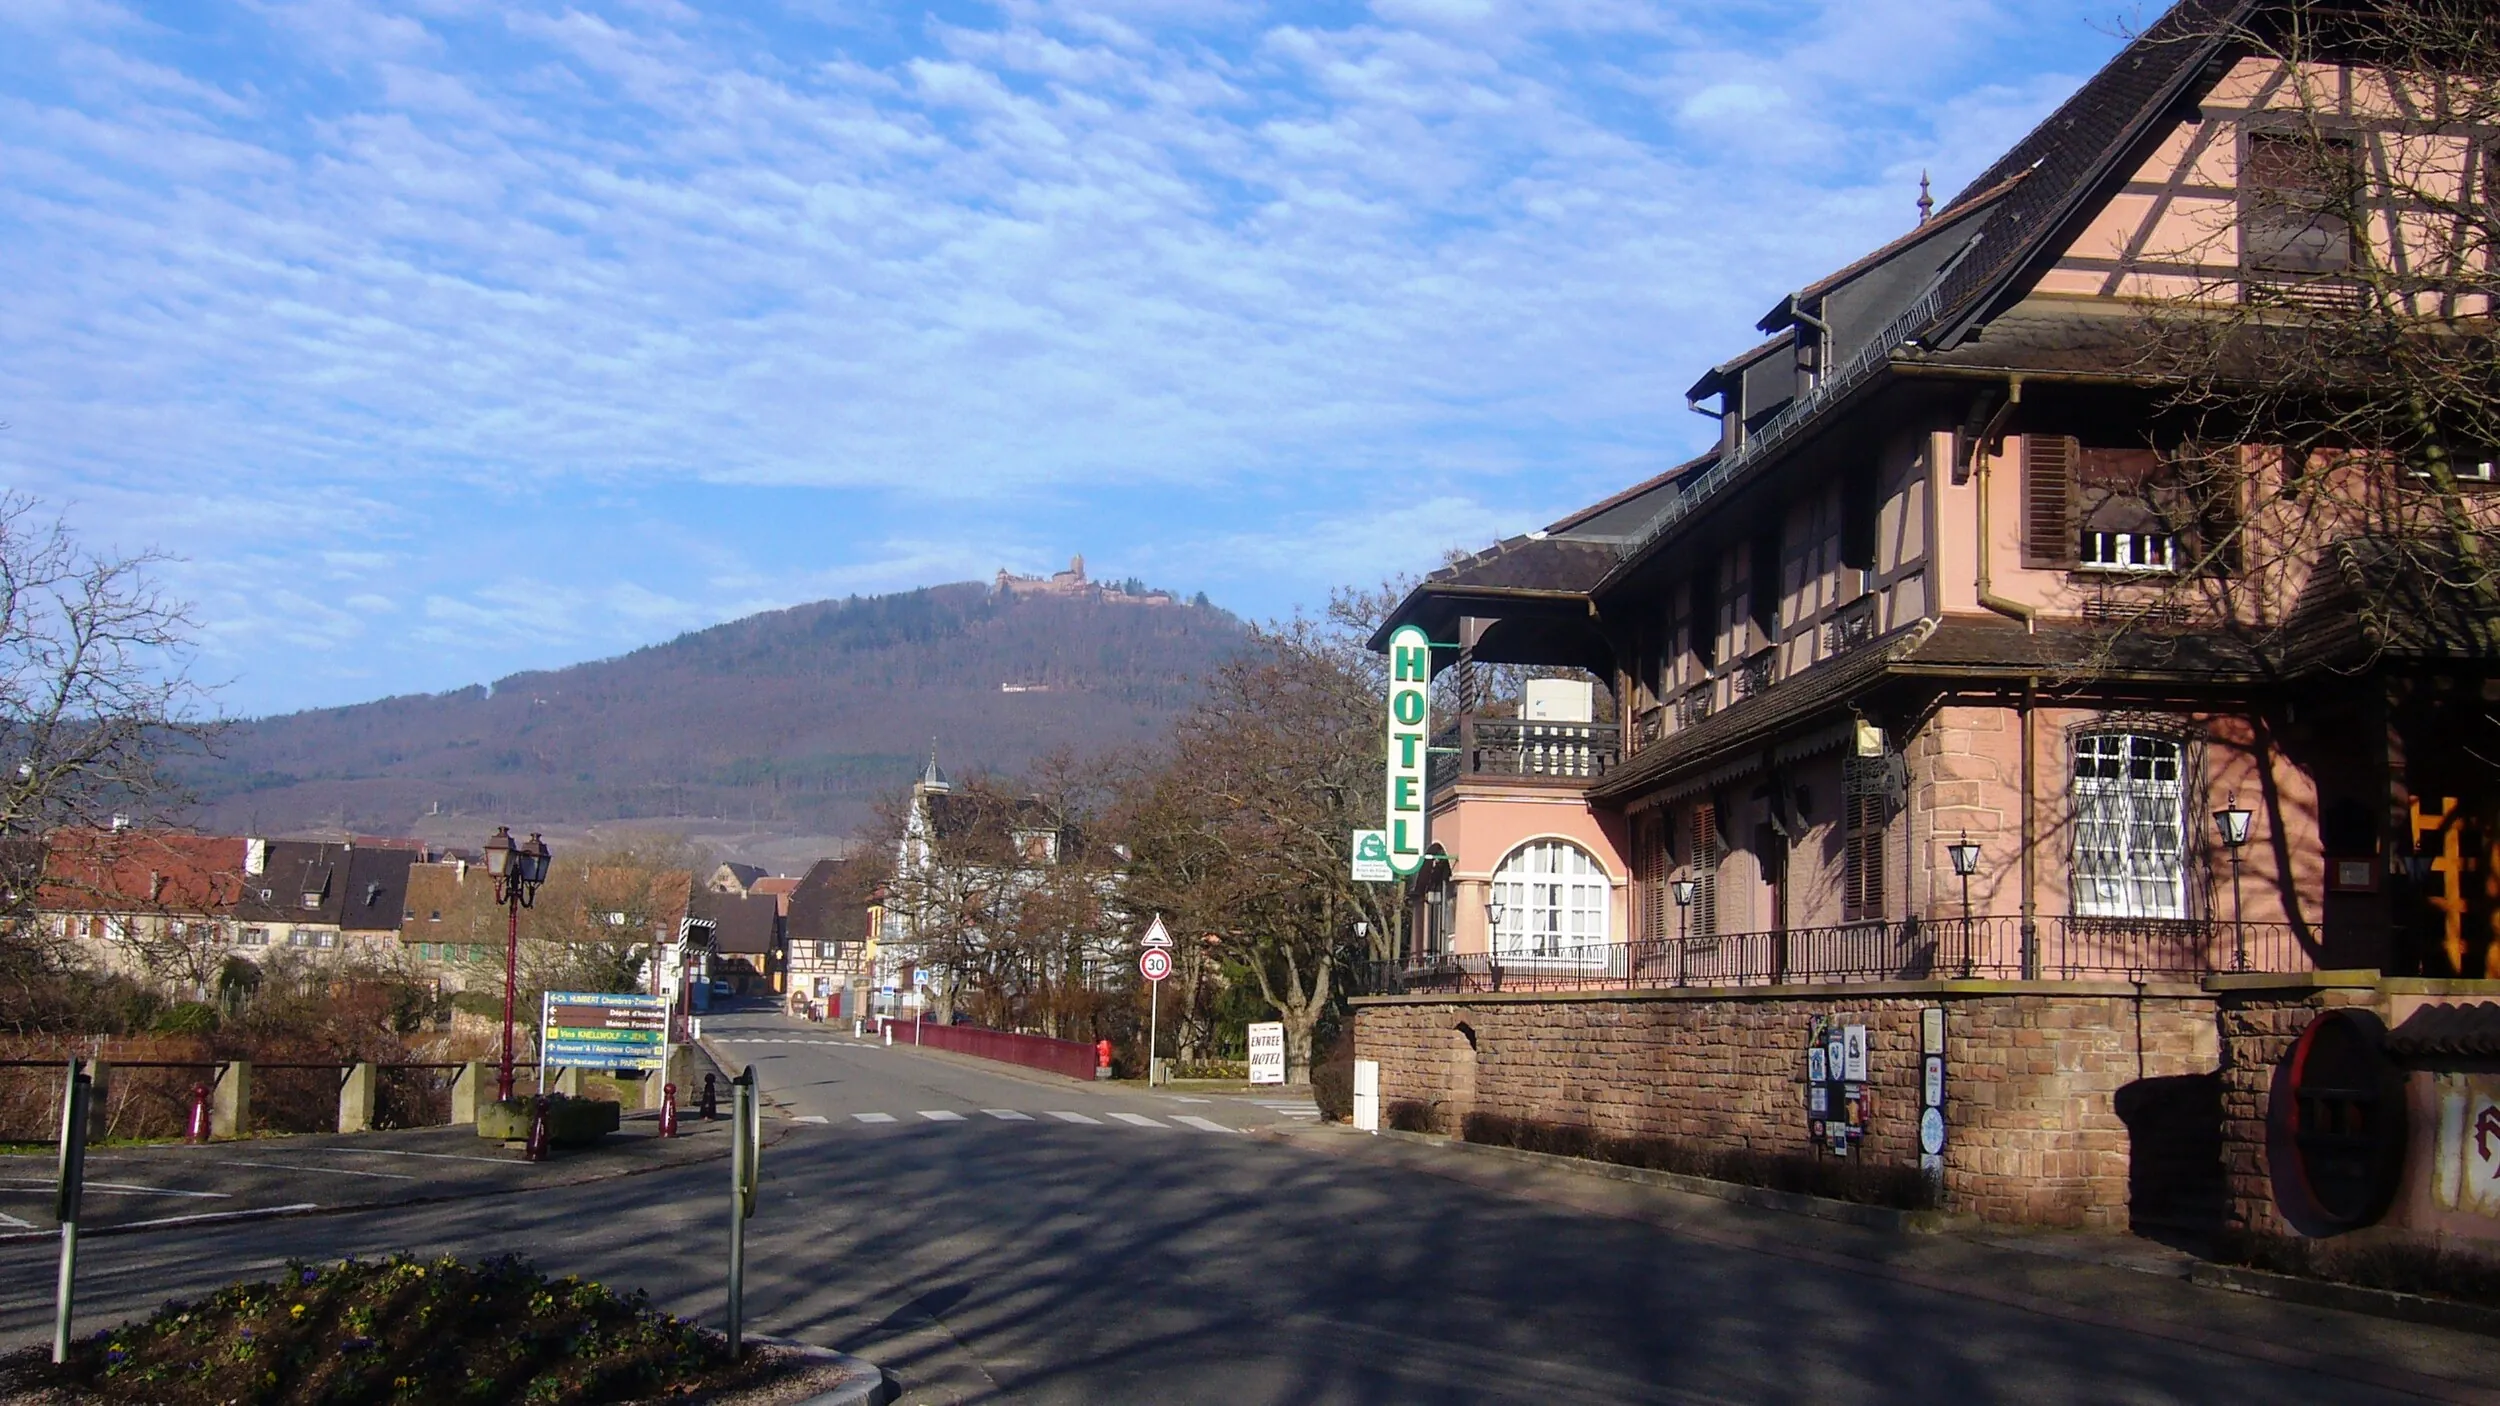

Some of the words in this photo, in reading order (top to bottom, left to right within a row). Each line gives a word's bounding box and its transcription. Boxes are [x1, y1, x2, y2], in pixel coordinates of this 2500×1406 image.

[1394, 646, 1425, 854] HOTEL
[1147, 959, 1163, 971] 30
[631, 1010, 664, 1018] d'Incendie
[560, 1030, 575, 1038] Vins
[1252, 1035, 1281, 1047] ENTREE
[1252, 1053, 1281, 1065] HOTEL
